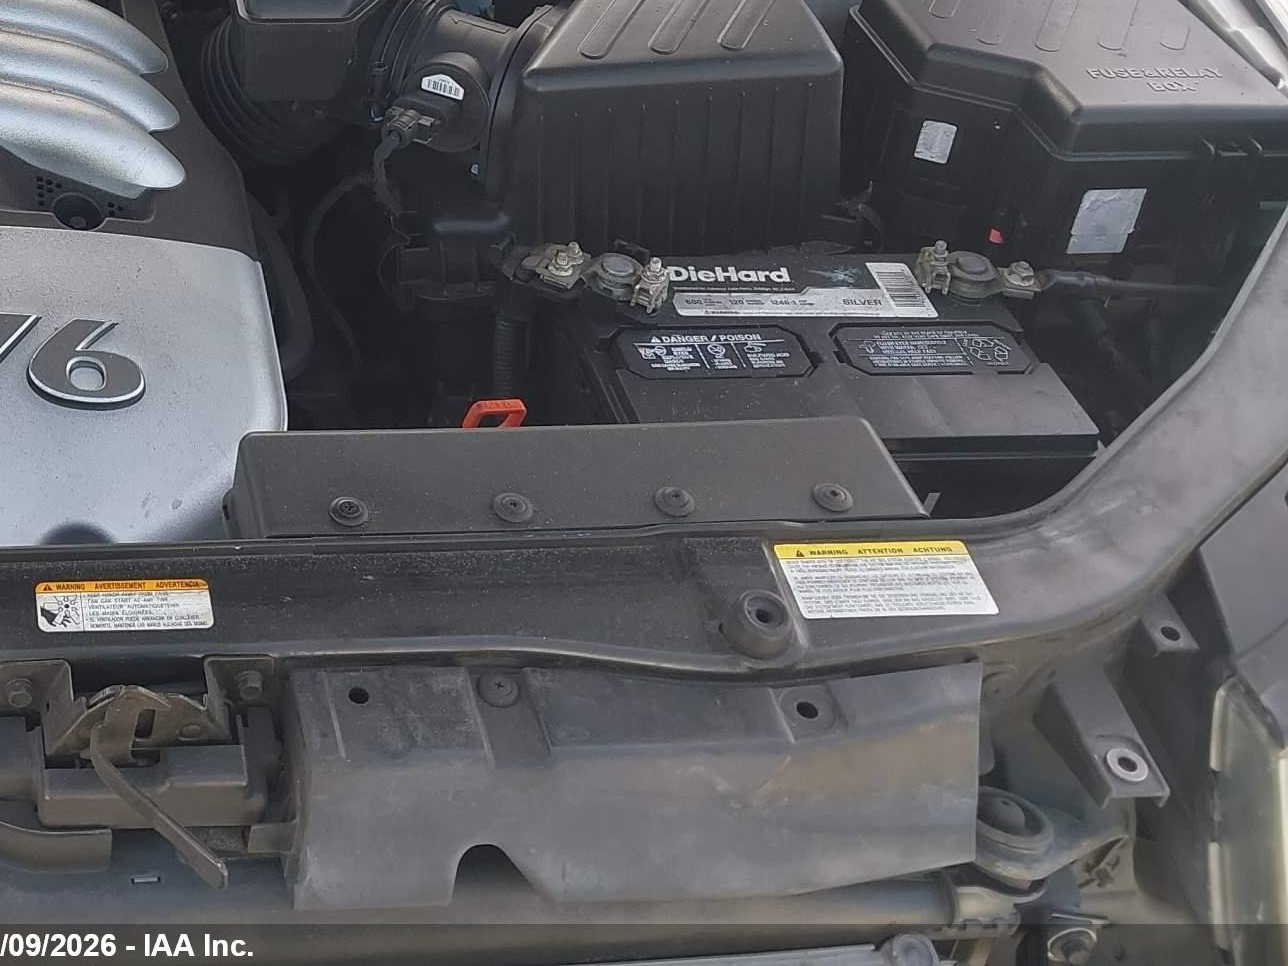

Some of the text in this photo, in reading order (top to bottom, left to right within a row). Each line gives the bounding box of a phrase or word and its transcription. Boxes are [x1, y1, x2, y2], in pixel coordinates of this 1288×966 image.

[1147, 81, 1200, 92] BOX
[668, 266, 791, 283] DieHard
[94, 582, 146, 590] AVERTISSEMENT
[156, 580, 200, 588] ADVERTENCIA
